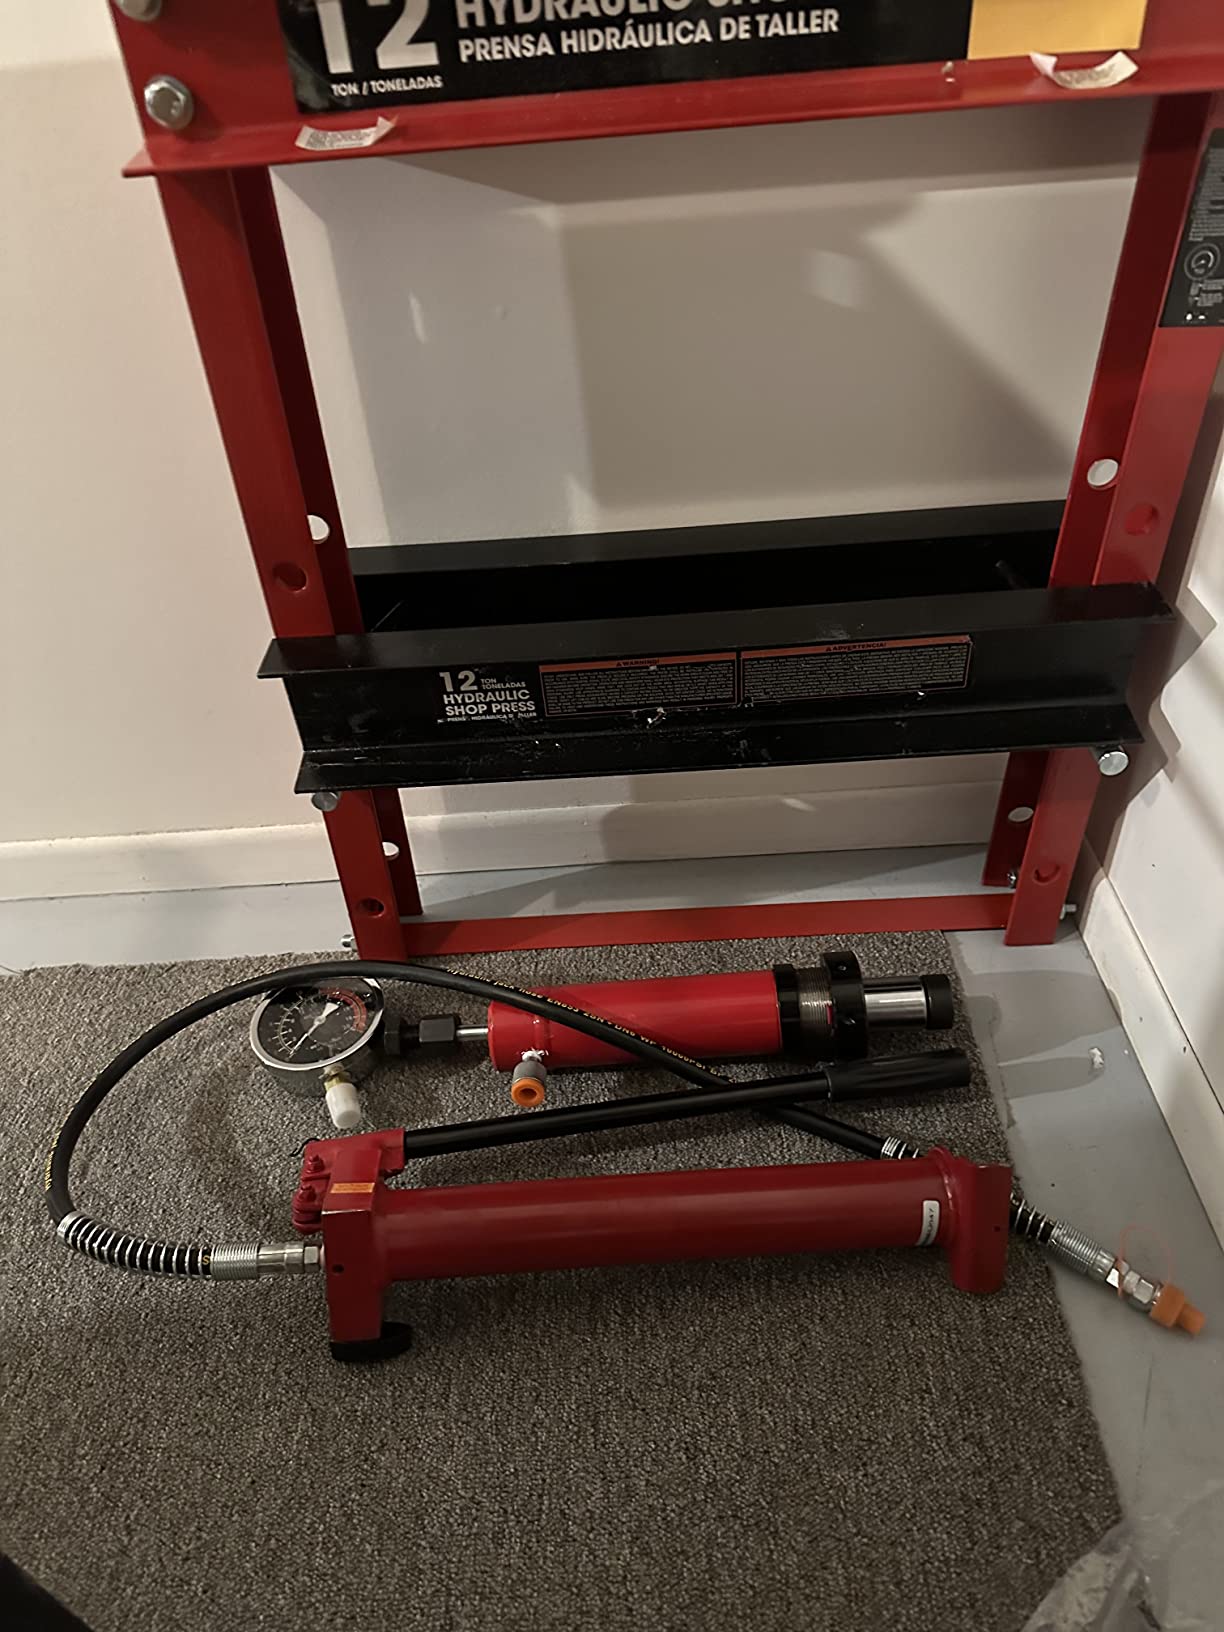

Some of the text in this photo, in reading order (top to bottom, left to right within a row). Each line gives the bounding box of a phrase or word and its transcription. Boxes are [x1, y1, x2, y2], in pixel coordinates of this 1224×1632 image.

[454, 0, 692, 28] HYDRA
[315, 0, 439, 74] 12
[459, 8, 839, 63] PRENSA HIDRÁULICA DE TALLER
[331, 83, 358, 96] TON
[370, 75, 443, 92] TONELADAS
[439, 670, 478, 692] 12
[482, 681, 526, 690] TONELADAS
[443, 689, 530, 705] HYDRAULIC
[445, 701, 535, 716] SHOP PRESS
